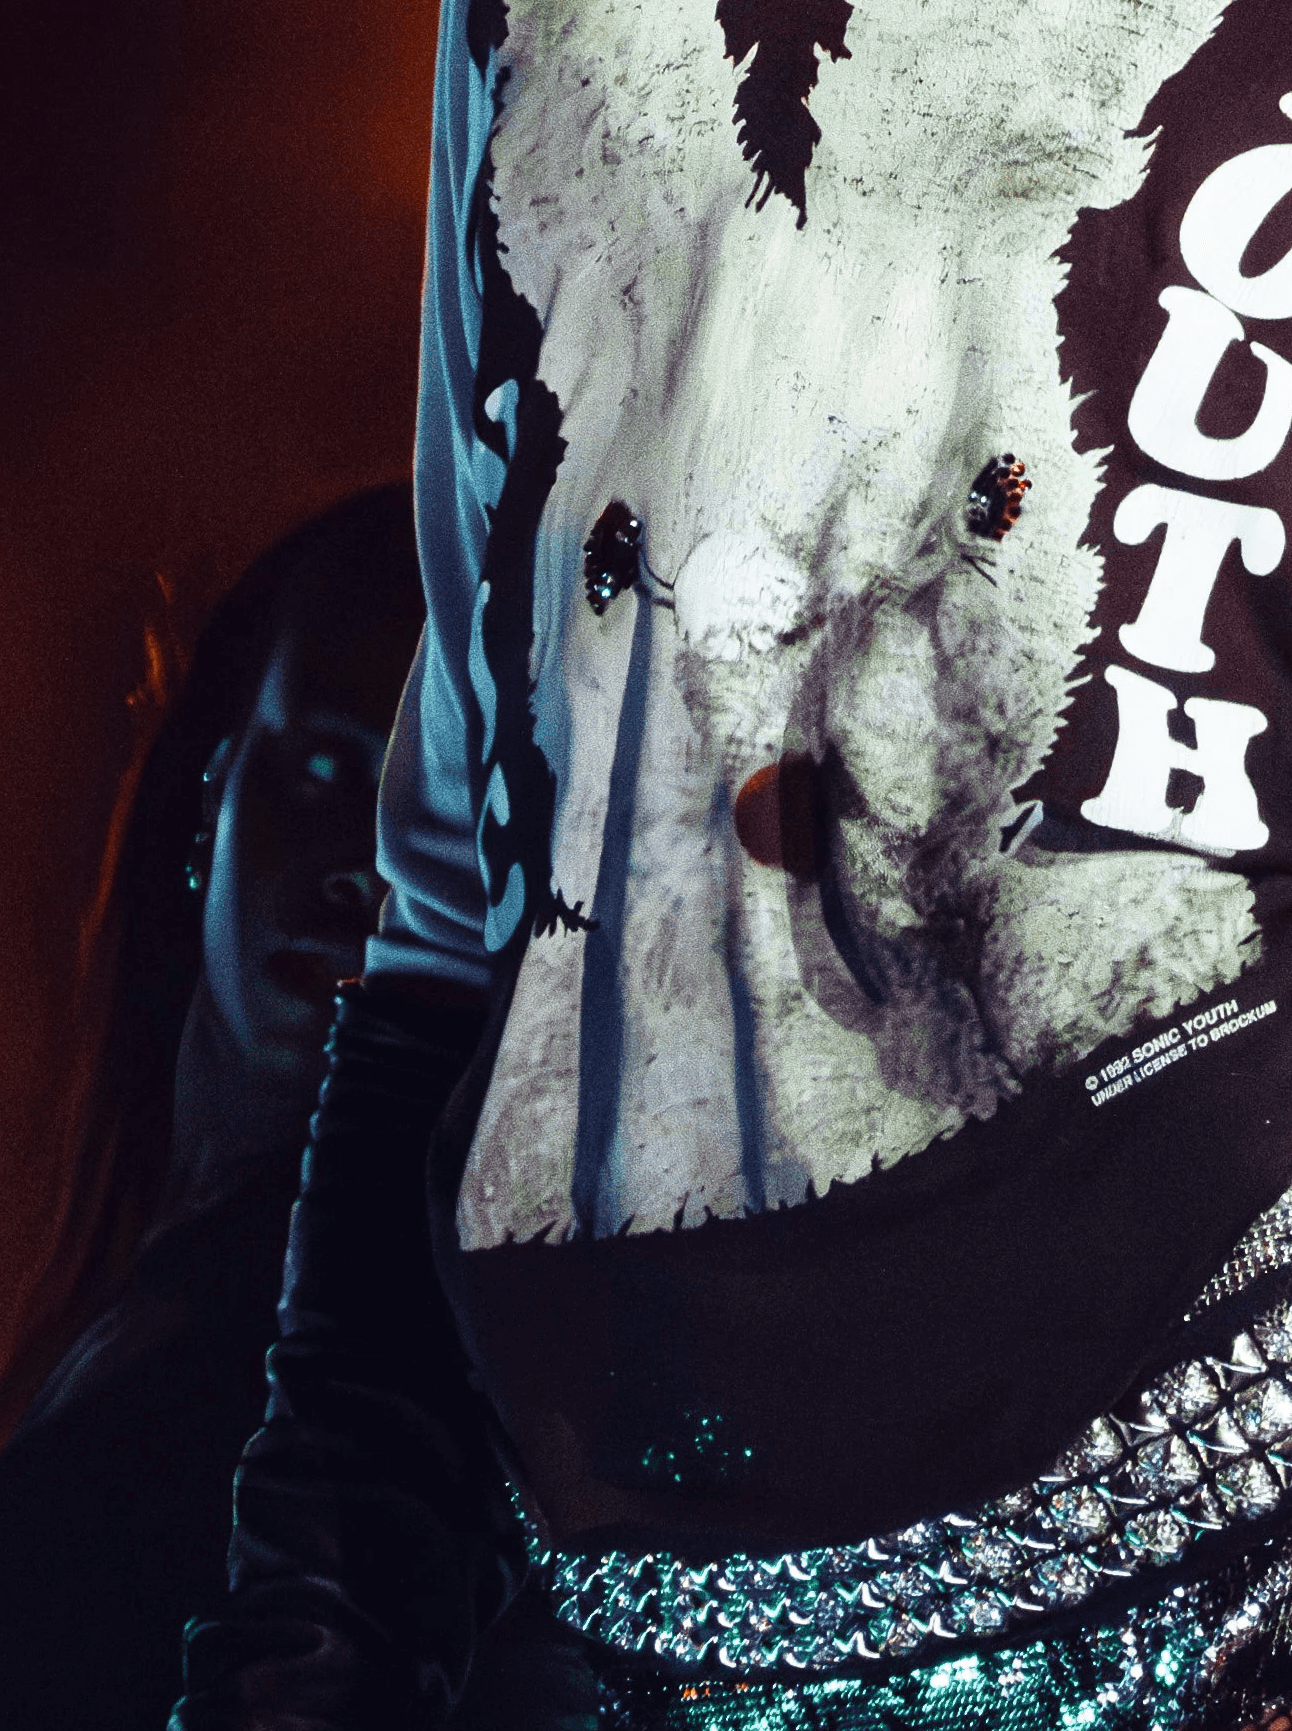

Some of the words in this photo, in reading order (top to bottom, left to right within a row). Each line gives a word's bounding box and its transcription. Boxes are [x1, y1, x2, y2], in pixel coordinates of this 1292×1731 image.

[1090, 1073, 1134, 1107] UNDER
[1132, 1042, 1188, 1083] LICENSE
[1186, 1033, 1210, 1051] TO
[1208, 999, 1278, 1042] BROCKUM
[1131, 1027, 1182, 1064] SONIC
[1181, 998, 1240, 1036] YOUTH
